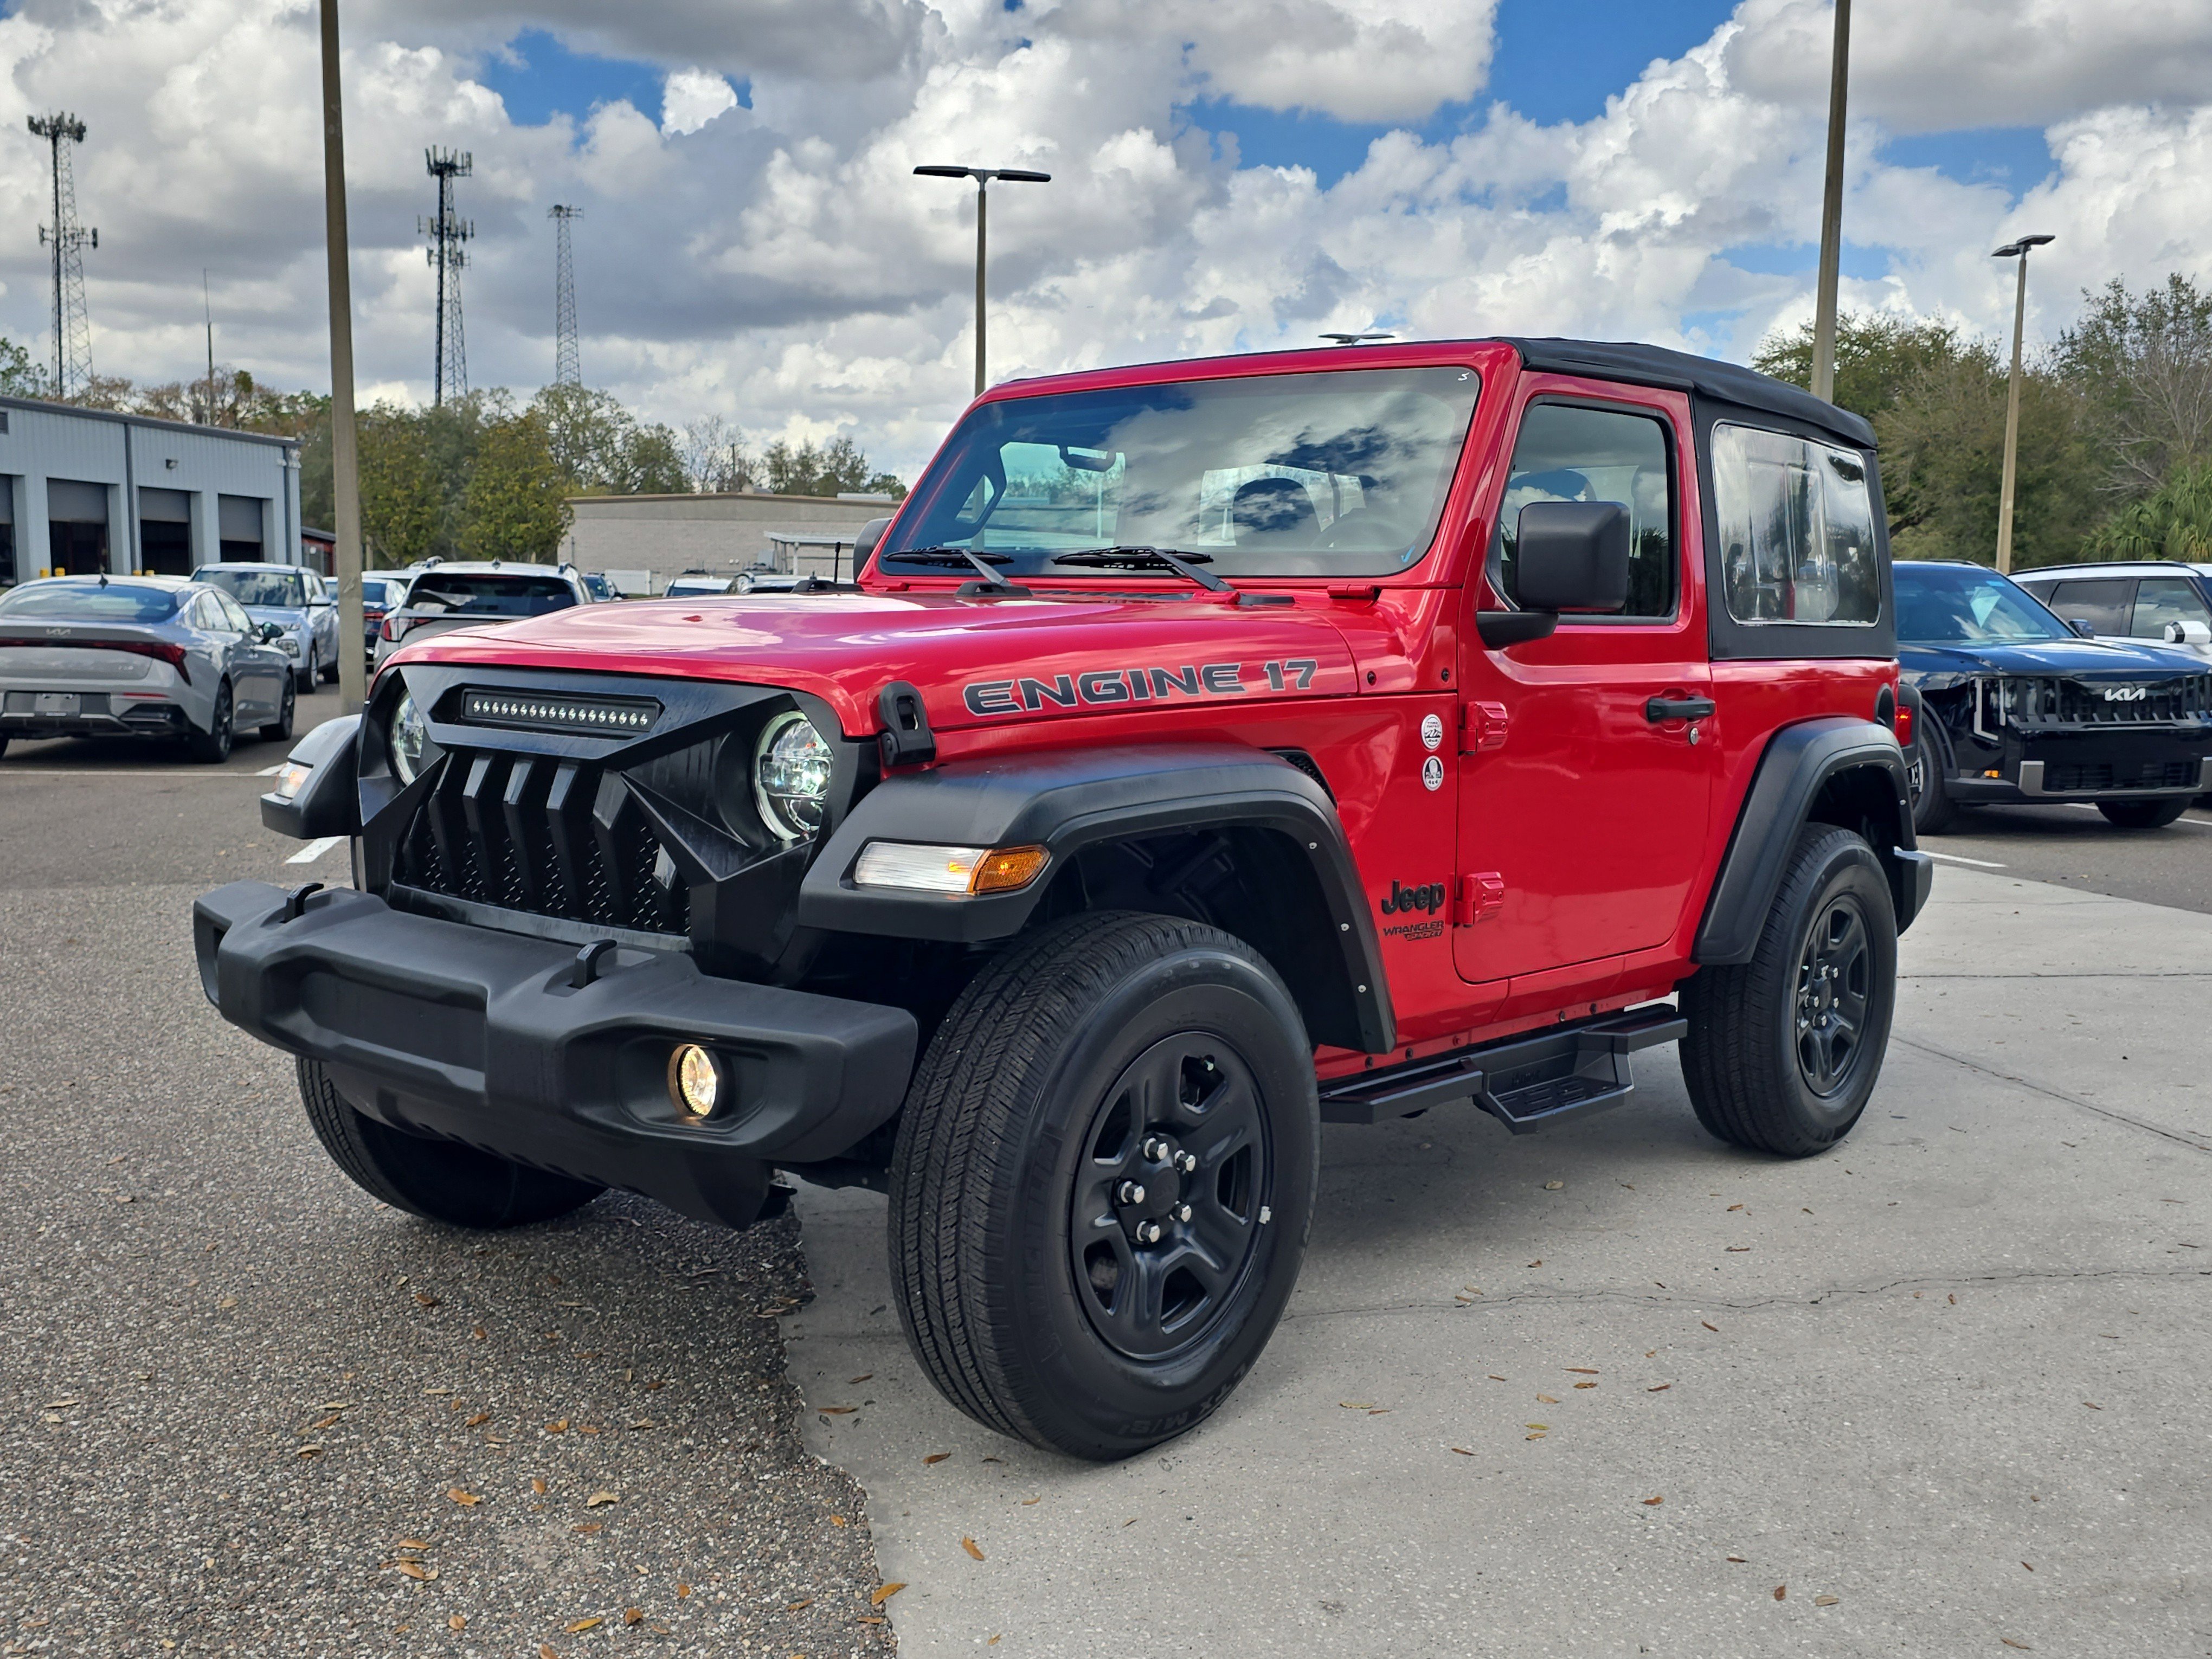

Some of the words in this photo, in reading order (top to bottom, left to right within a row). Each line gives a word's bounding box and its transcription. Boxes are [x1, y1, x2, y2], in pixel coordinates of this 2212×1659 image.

[963, 663, 1245, 716] ENGINE
[1263, 659, 1317, 690] 17
[2105, 688, 2146, 701] KIA
[1381, 879, 1446, 915] Jeep
[1383, 920, 1444, 936] WRANGLER
